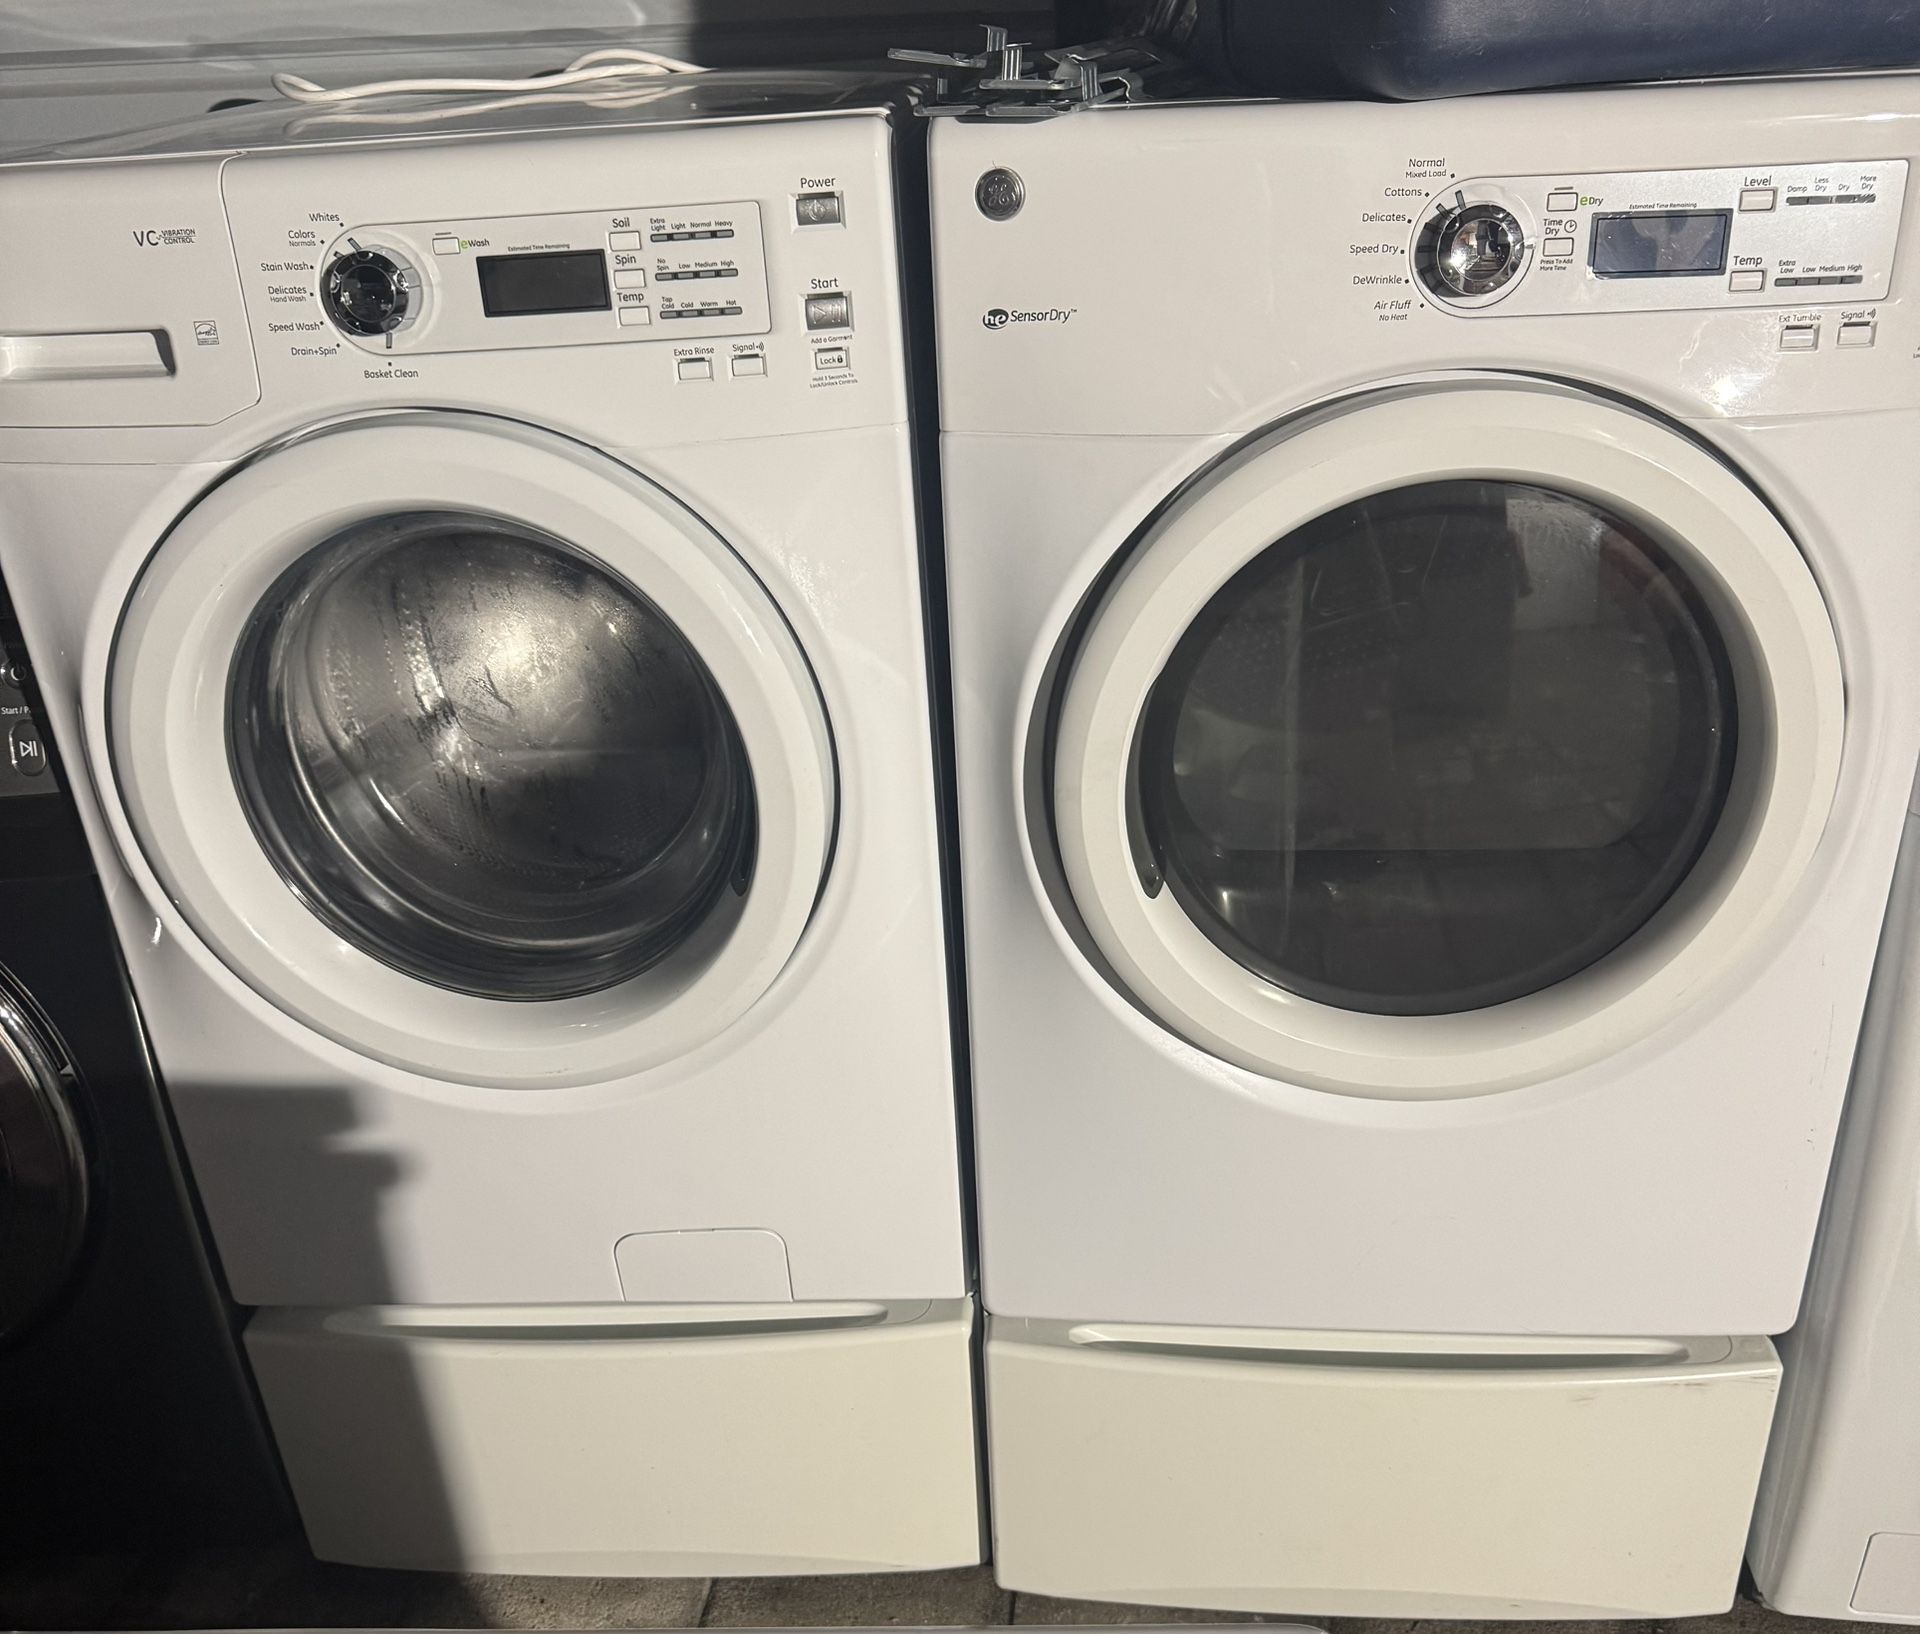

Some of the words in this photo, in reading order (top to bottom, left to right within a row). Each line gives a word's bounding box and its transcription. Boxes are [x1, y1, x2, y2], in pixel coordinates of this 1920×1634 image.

[1408, 158, 1445, 167] Normal
[800, 177, 836, 189] Power
[1744, 175, 1772, 187] Level
[1384, 188, 1422, 197] Cottons
[1787, 185, 1808, 193] Damp
[1815, 184, 1827, 192] Dry
[1838, 183, 1850, 192] Dry
[1861, 182, 1874, 191] Dry
[1579, 195, 1604, 207] eDry
[309, 213, 340, 222] Whites
[612, 217, 630, 228] Soil
[650, 217, 665, 225] Extra
[1362, 213, 1406, 222] Delicates
[1543, 218, 1563, 227] Time
[651, 224, 666, 232] Light
[671, 223, 686, 231] Light
[690, 221, 712, 229] Normal
[1545, 227, 1560, 236] Dry
[133, 230, 159, 247] VC
[161, 228, 196, 237] VIBRATION
[288, 230, 316, 239] Colors
[164, 237, 195, 245] CONTROL
[461, 238, 490, 250] eWash
[1349, 245, 1379, 256] Speed
[1381, 244, 1399, 255] Dry
[615, 254, 637, 266] Spin
[721, 260, 735, 268] High
[1733, 255, 1763, 267] Temp
[1778, 259, 1796, 267] Extra
[260, 262, 284, 272] Stain
[284, 261, 309, 271] Wash
[1780, 266, 1794, 274] Low
[1847, 264, 1863, 273] High
[811, 278, 839, 290] Start
[1353, 275, 1403, 285] DeWrinkle
[268, 285, 307, 295] Delicates
[285, 295, 307, 303] Wash
[617, 292, 645, 304] Temp
[1374, 301, 1389, 310] Air
[1389, 299, 1412, 310] Fluff
[983, 308, 1009, 330] he
[1379, 314, 1389, 322] No
[1793, 313, 1822, 322] Tumble
[1841, 310, 1865, 321] Signal
[268, 323, 295, 333] Speed
[296, 322, 320, 331] Wash
[828, 334, 853, 343] Garment
[291, 347, 337, 357] Drain+Spin
[673, 347, 693, 357] Extra
[695, 346, 715, 356] Rinse
[732, 342, 756, 353] Signal
[820, 357, 836, 365] Lock
[364, 370, 393, 379] Basket
[394, 369, 419, 378] Clean
[1, 706, 18, 715] Start
